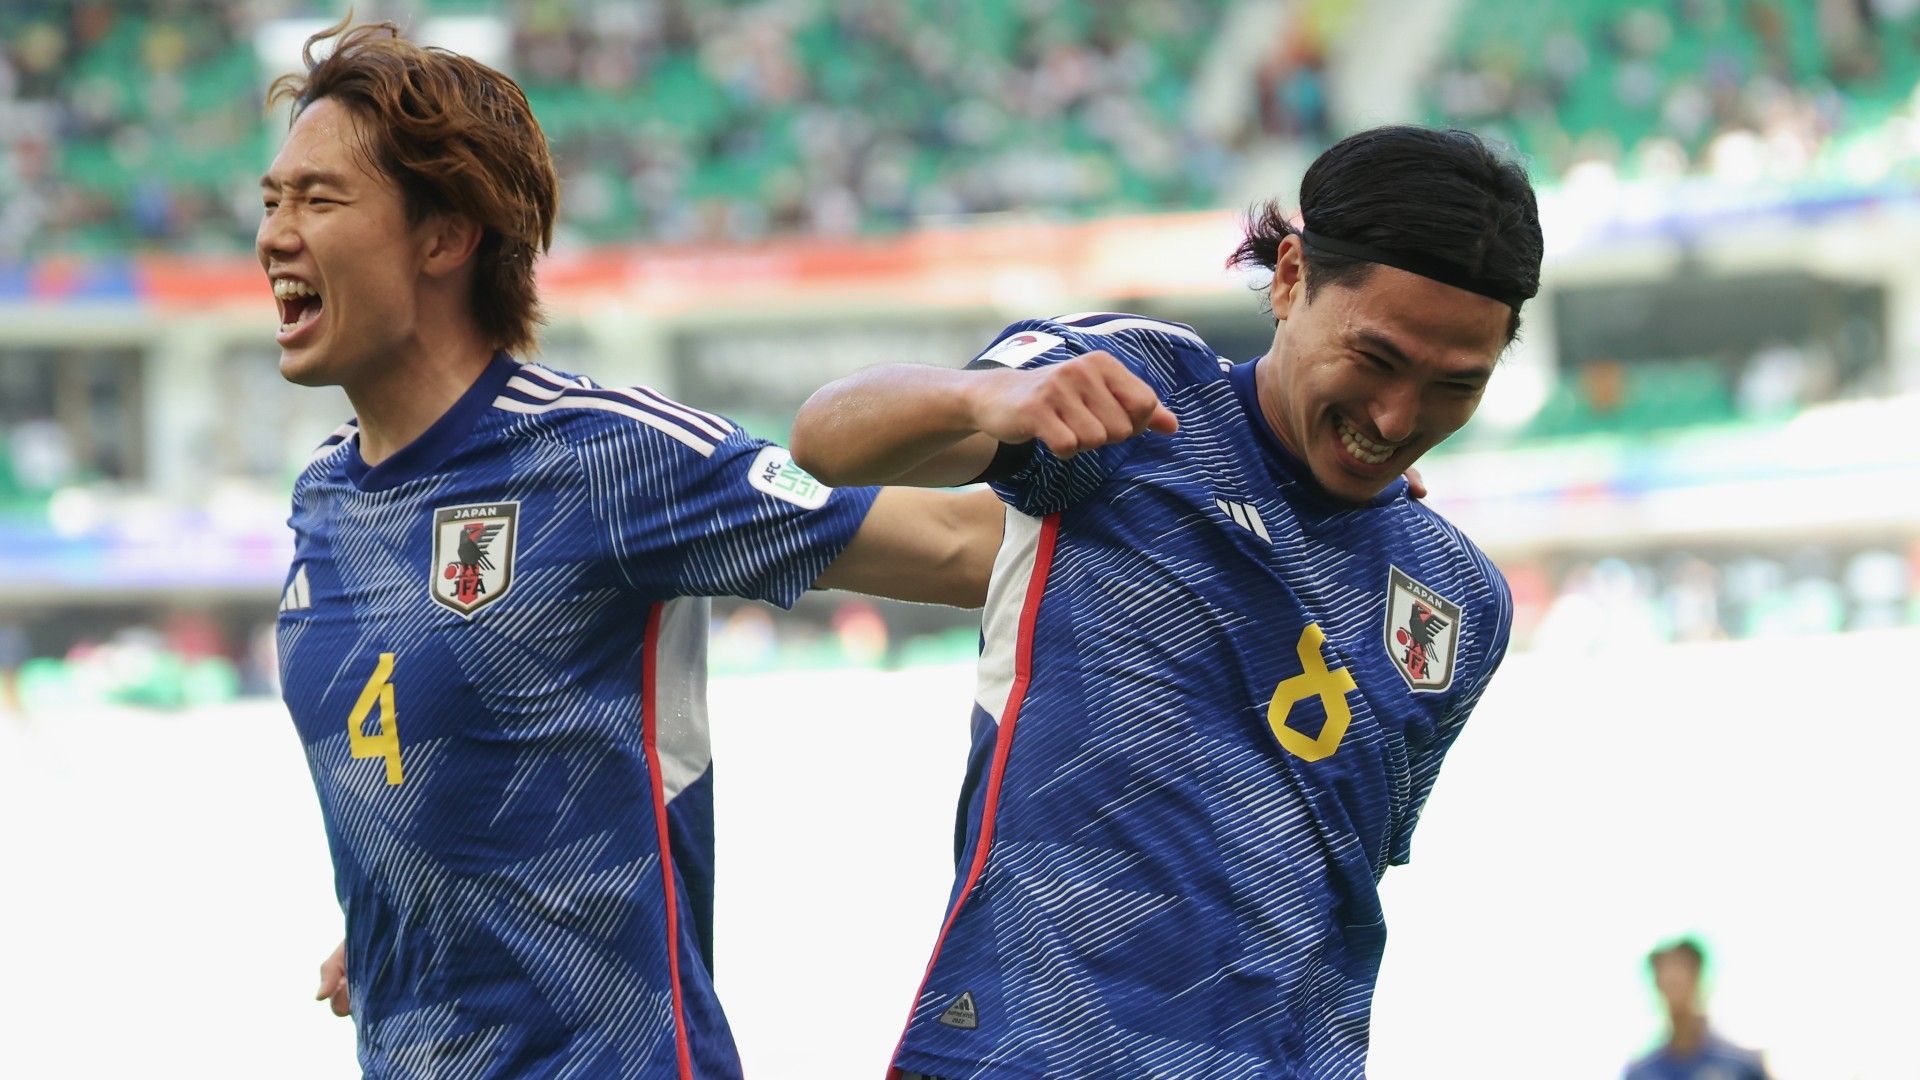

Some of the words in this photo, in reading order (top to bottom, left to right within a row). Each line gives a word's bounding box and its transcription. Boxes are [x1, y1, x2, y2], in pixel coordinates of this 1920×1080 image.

[761, 461, 782, 484] AFC
[453, 507, 497, 519] JAPAN
[449, 578, 487, 597] JFA
[1406, 582, 1443, 609] JAPAN
[1400, 649, 1431, 680] JFA
[347, 652, 404, 786] 4
